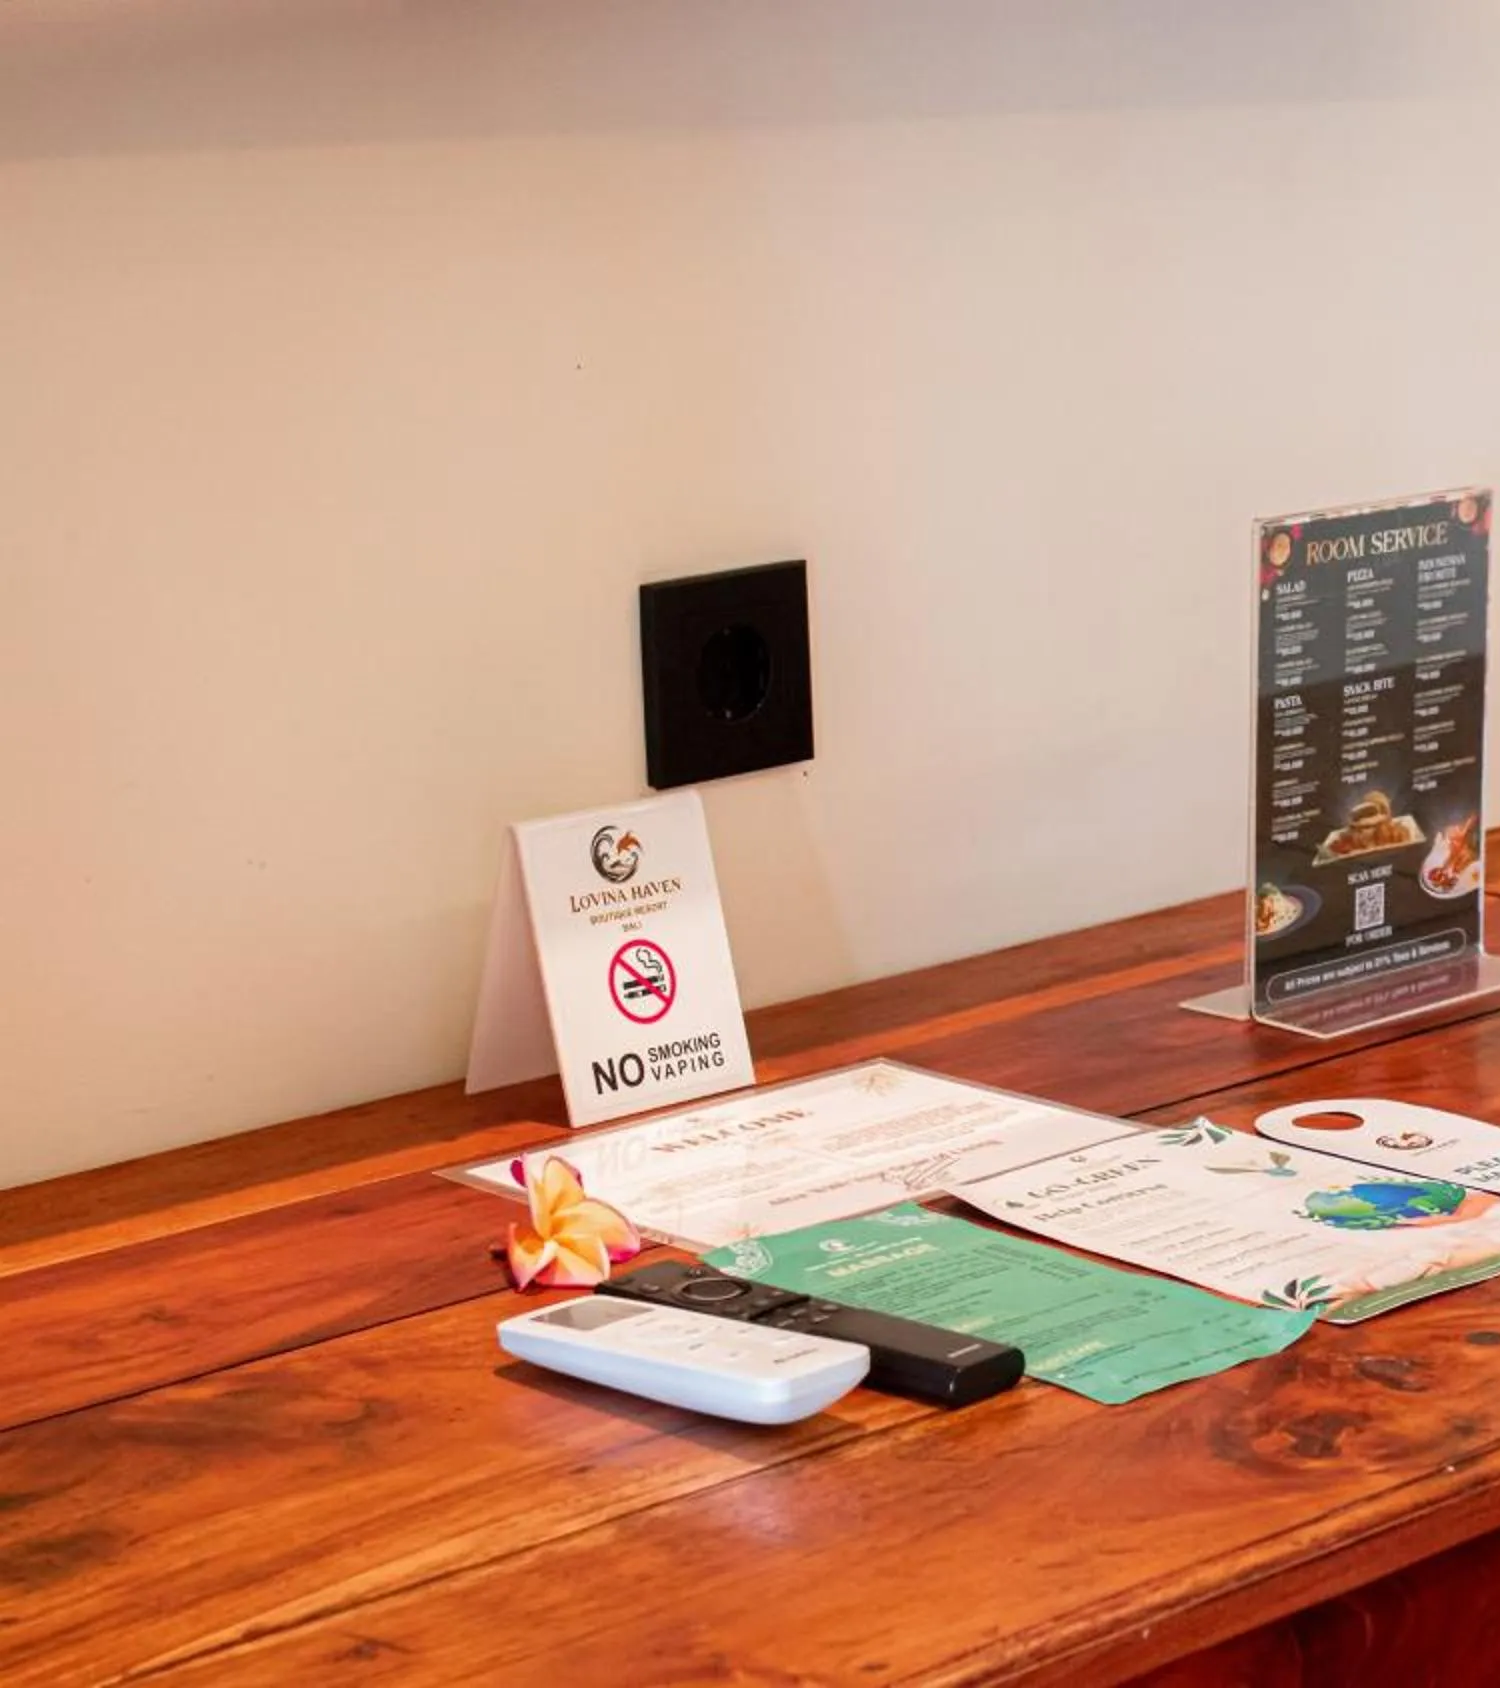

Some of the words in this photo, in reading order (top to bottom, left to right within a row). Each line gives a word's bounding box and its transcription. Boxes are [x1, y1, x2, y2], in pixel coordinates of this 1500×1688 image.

[1306, 537, 1366, 566] ROOM
[1370, 522, 1449, 555] SERVICE
[1347, 569, 1374, 583] PIZZA
[1276, 580, 1307, 594] SALAD
[1343, 681, 1371, 697] SNACK
[1274, 695, 1303, 710] PASTA
[570, 890, 627, 913] LOVINA
[631, 878, 682, 901] HAVEN
[1345, 933, 1364, 948] FOR
[591, 1053, 646, 1095] NO
[647, 1032, 721, 1063] SMOKING
[650, 1051, 725, 1082] VAPING
